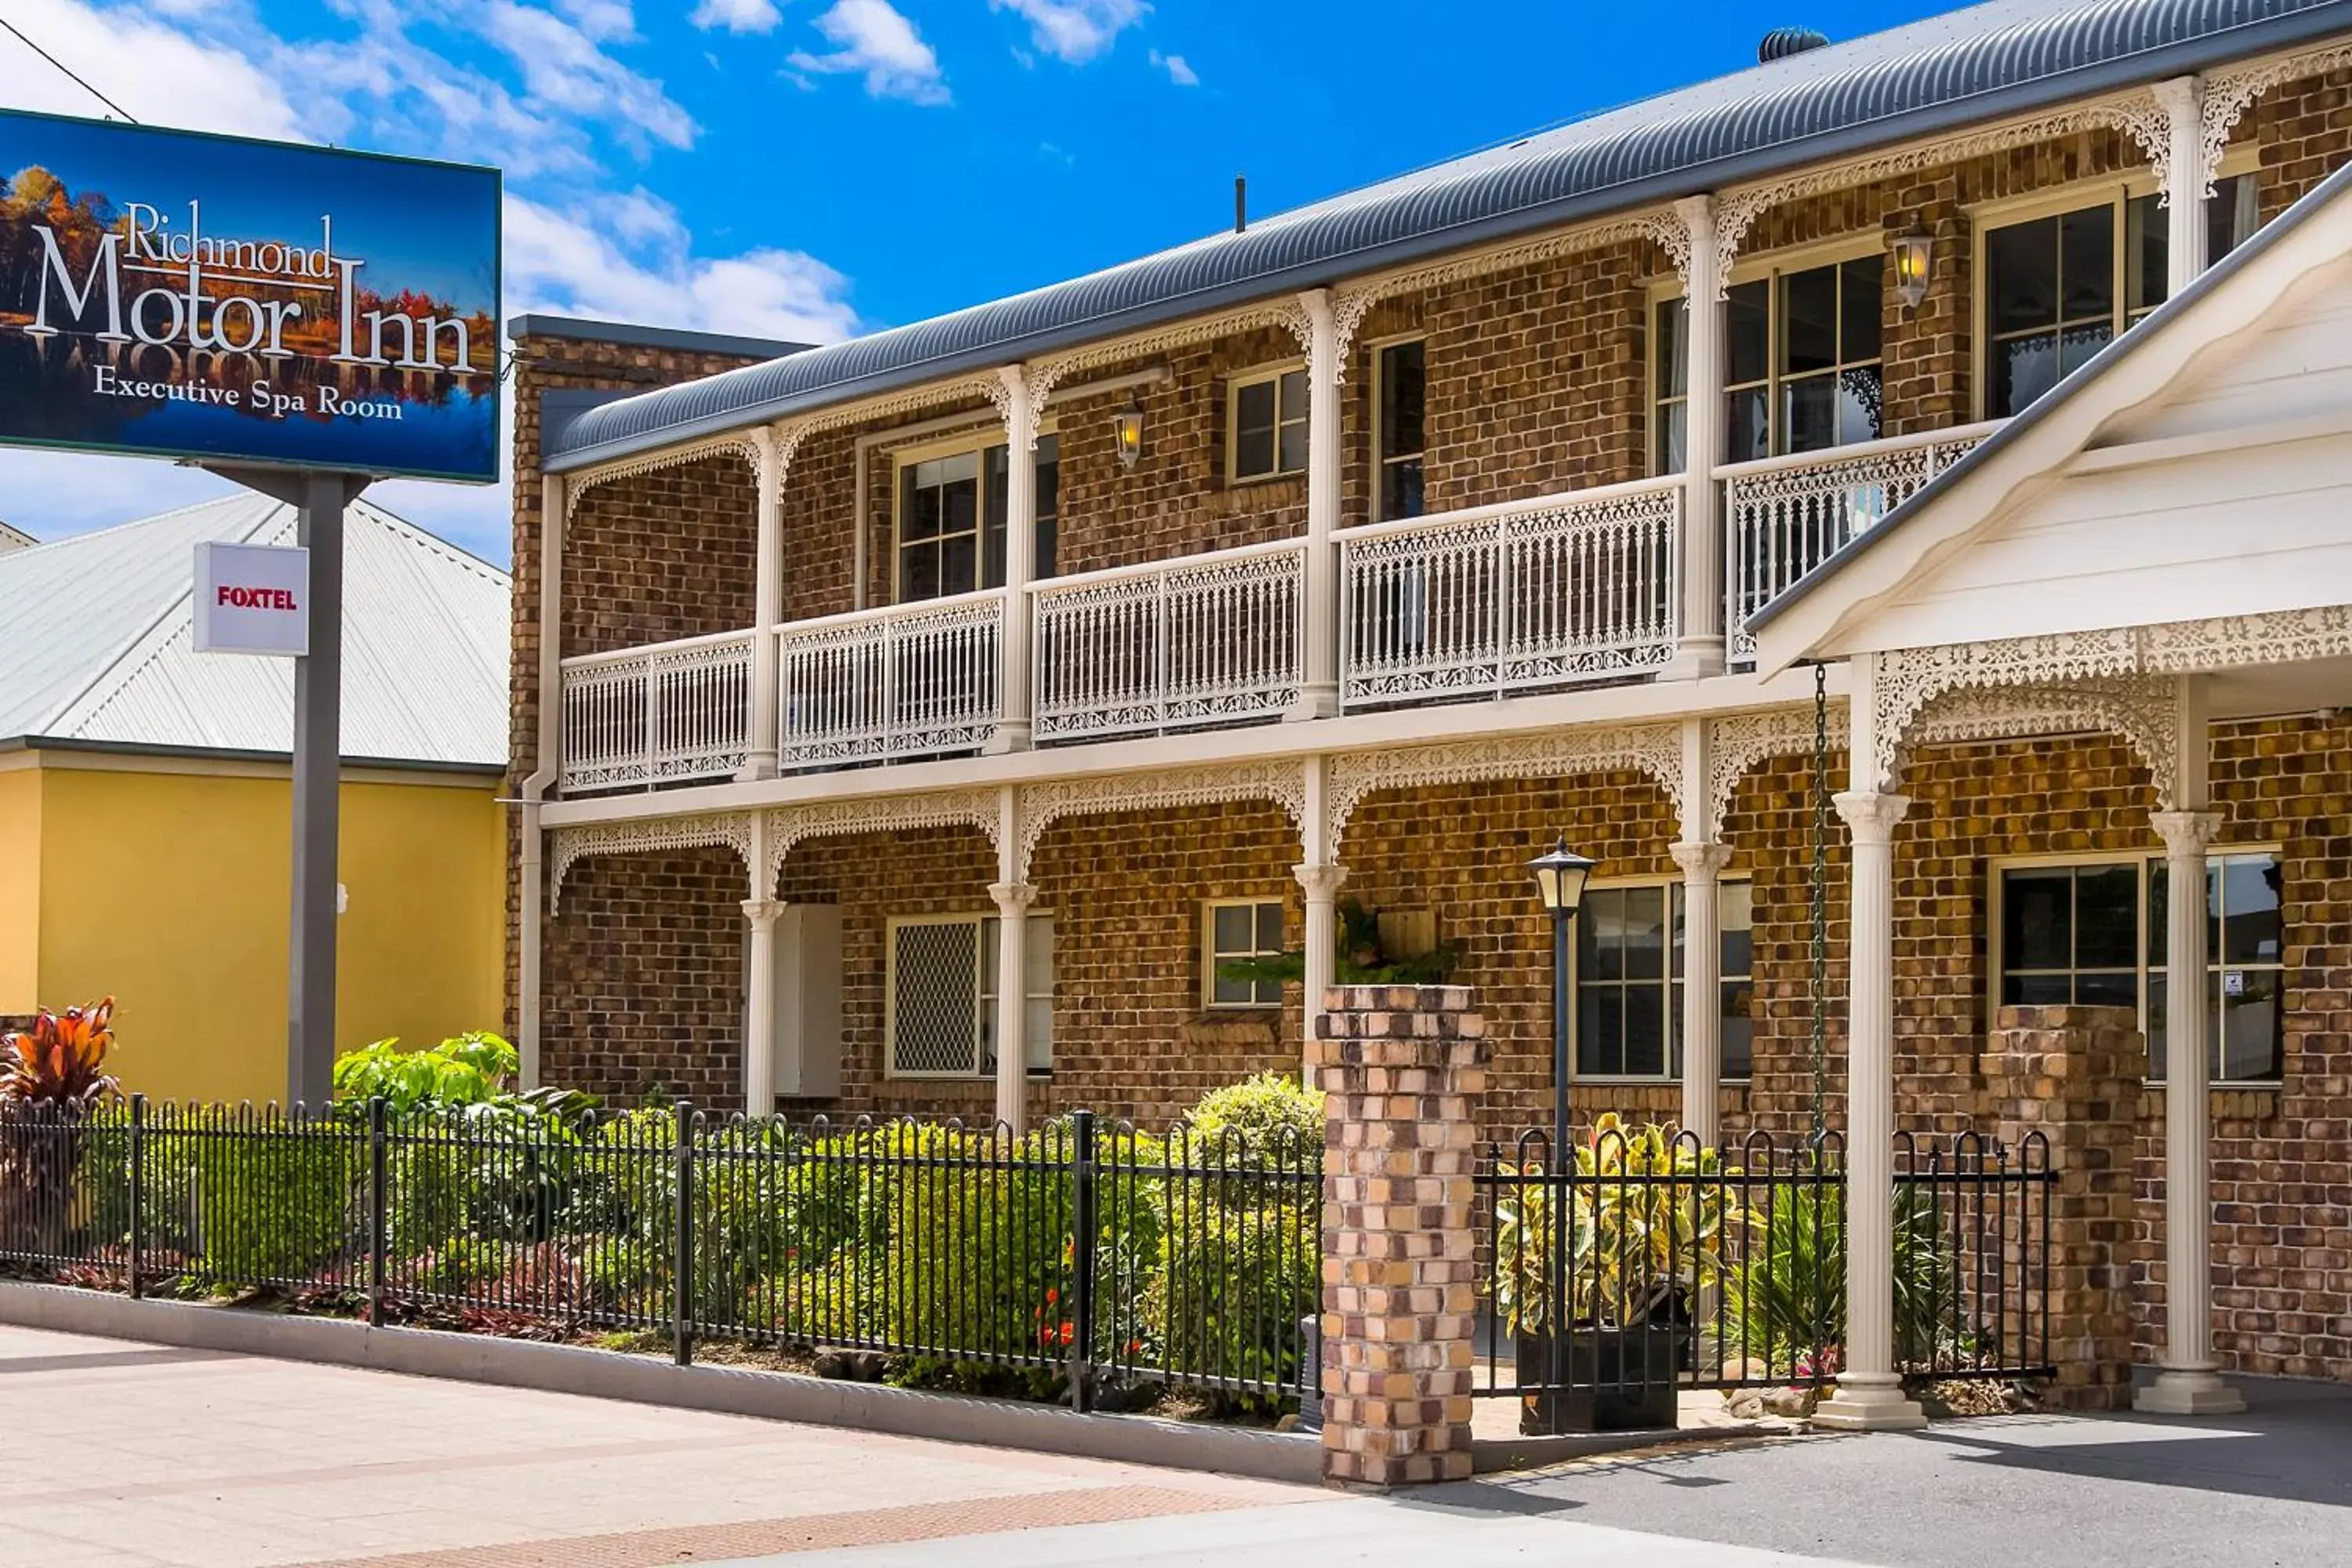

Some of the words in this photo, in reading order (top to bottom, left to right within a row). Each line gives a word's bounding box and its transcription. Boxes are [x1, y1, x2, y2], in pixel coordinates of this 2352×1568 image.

[125, 198, 336, 279] Richmond
[23, 224, 302, 357] Motor
[328, 257, 477, 373] Inn
[93, 365, 240, 406] Executive
[251, 379, 307, 418] Spa
[318, 386, 404, 420] Room
[217, 586, 297, 611] FOXTEL
